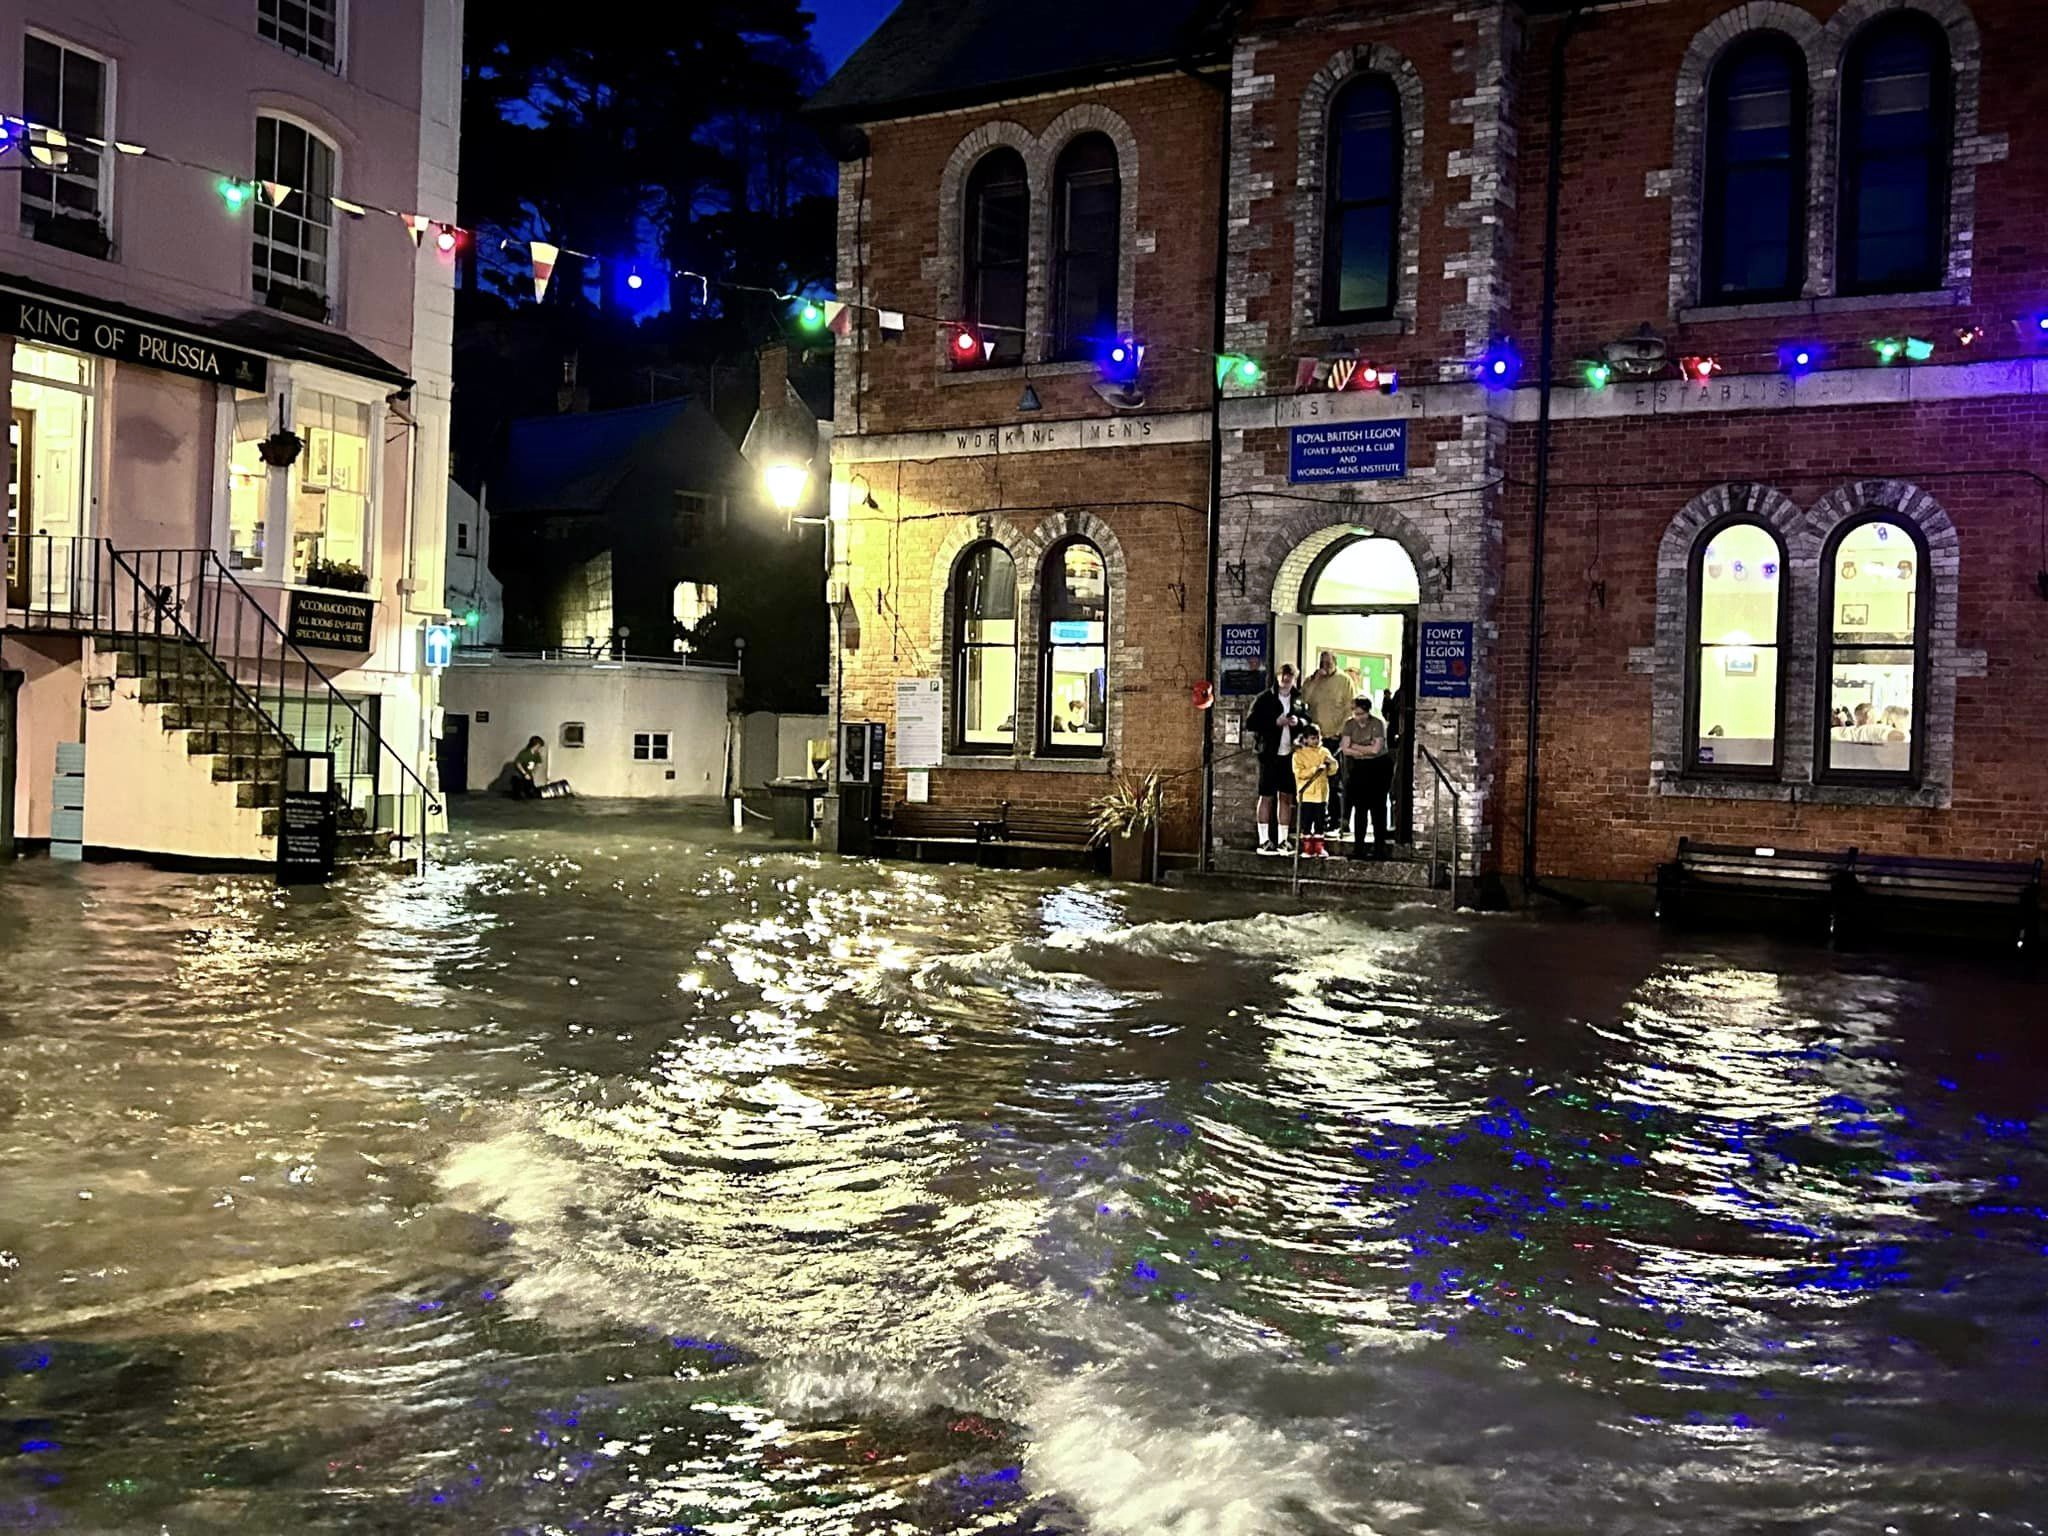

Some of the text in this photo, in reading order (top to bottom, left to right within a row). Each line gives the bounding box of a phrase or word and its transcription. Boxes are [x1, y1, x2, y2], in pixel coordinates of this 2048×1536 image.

[19, 304, 220, 376] KING OF PRUSSIA
[1296, 427, 1401, 444] ROYAL BRITISH LEGION
[1303, 442, 1395, 456] FOWEY BRANCH & CLUB
[1339, 455, 1357, 464] AND
[1297, 463, 1400, 477] WORKING MENS INSTITUTE
[298, 600, 366, 616] ACCOMMODATION
[298, 616, 365, 632] ALL ROOMS EN-SUITE
[296, 629, 363, 644] SPECTACULAR VIEWS
[1226, 628, 1259, 639] FOWEY
[1426, 628, 1463, 639] FOWEY
[1225, 645, 1261, 656] LEGION
[1425, 646, 1465, 657] LEGION
